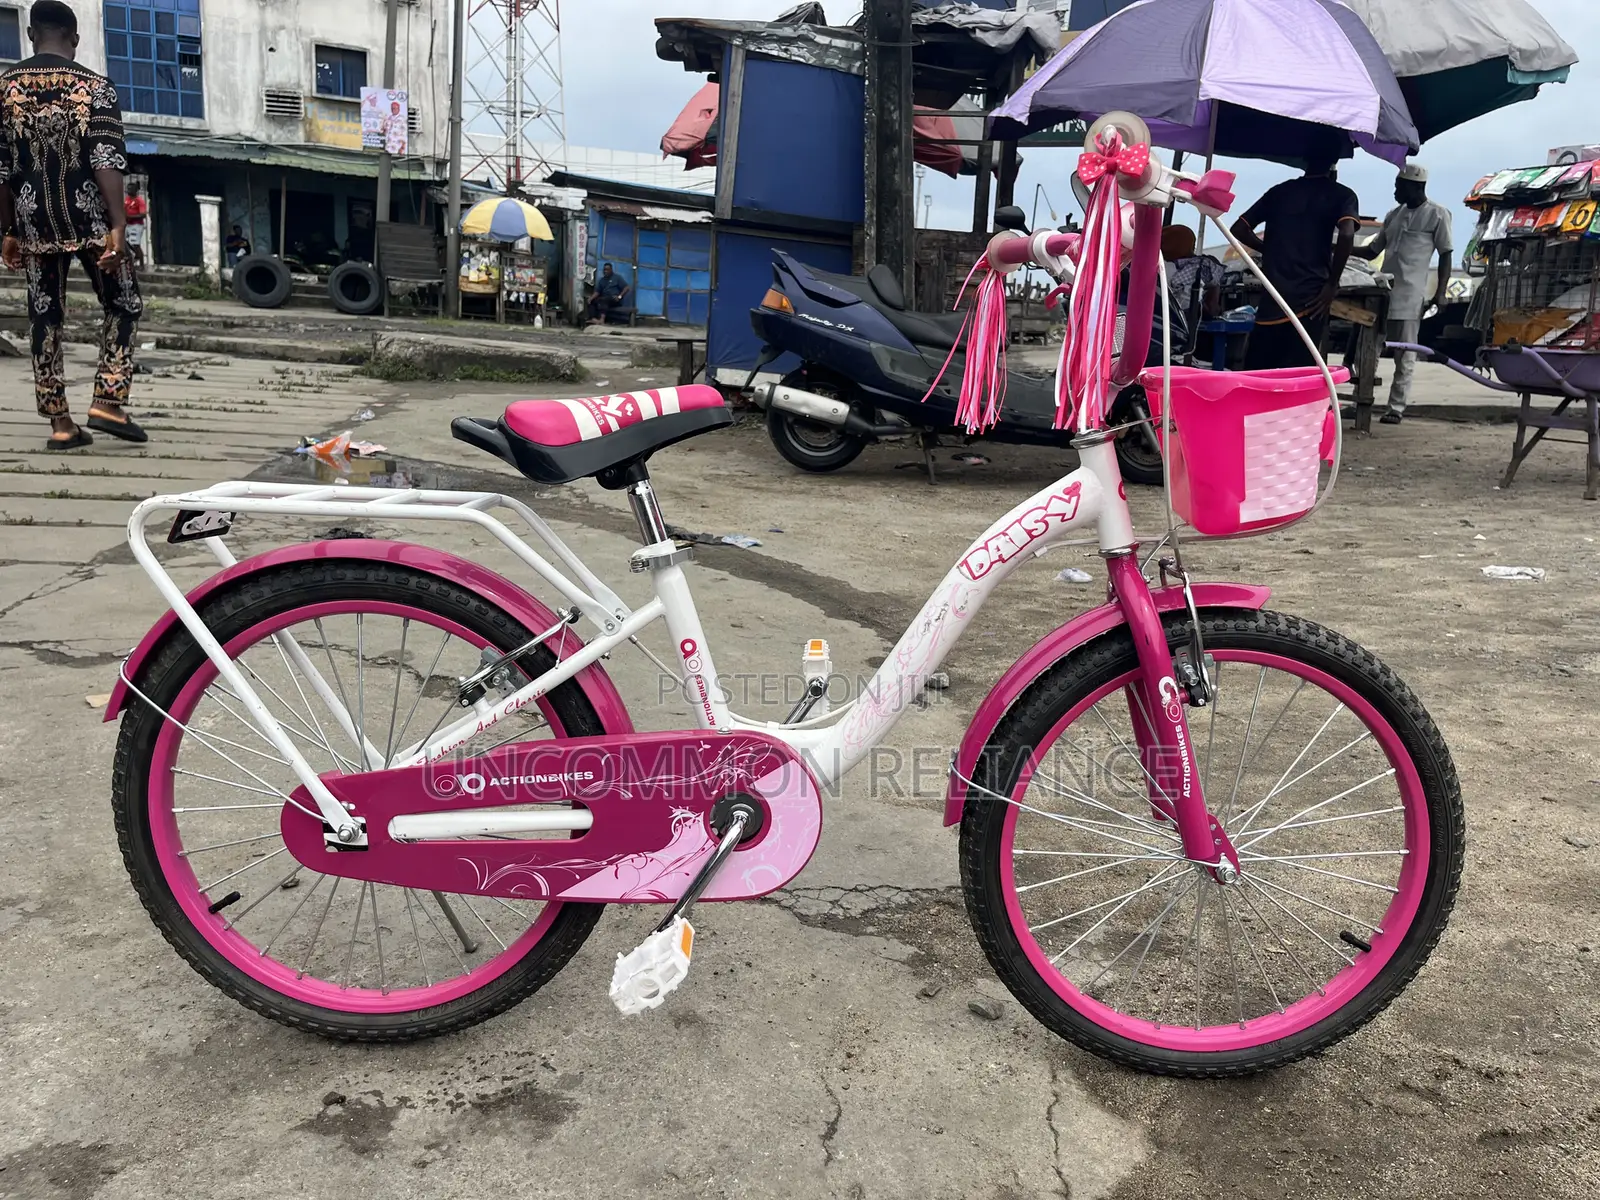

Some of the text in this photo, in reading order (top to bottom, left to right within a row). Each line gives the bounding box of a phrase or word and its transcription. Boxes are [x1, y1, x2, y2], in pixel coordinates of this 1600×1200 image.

[957, 482, 1081, 580] DAISY
[416, 687, 547, 765] Fashion And Classic
[694, 673, 716, 726] ACTIONBIKES
[489, 771, 594, 787] ACTIONBIKES
[1175, 725, 1191, 798] ACTIONBIKES
